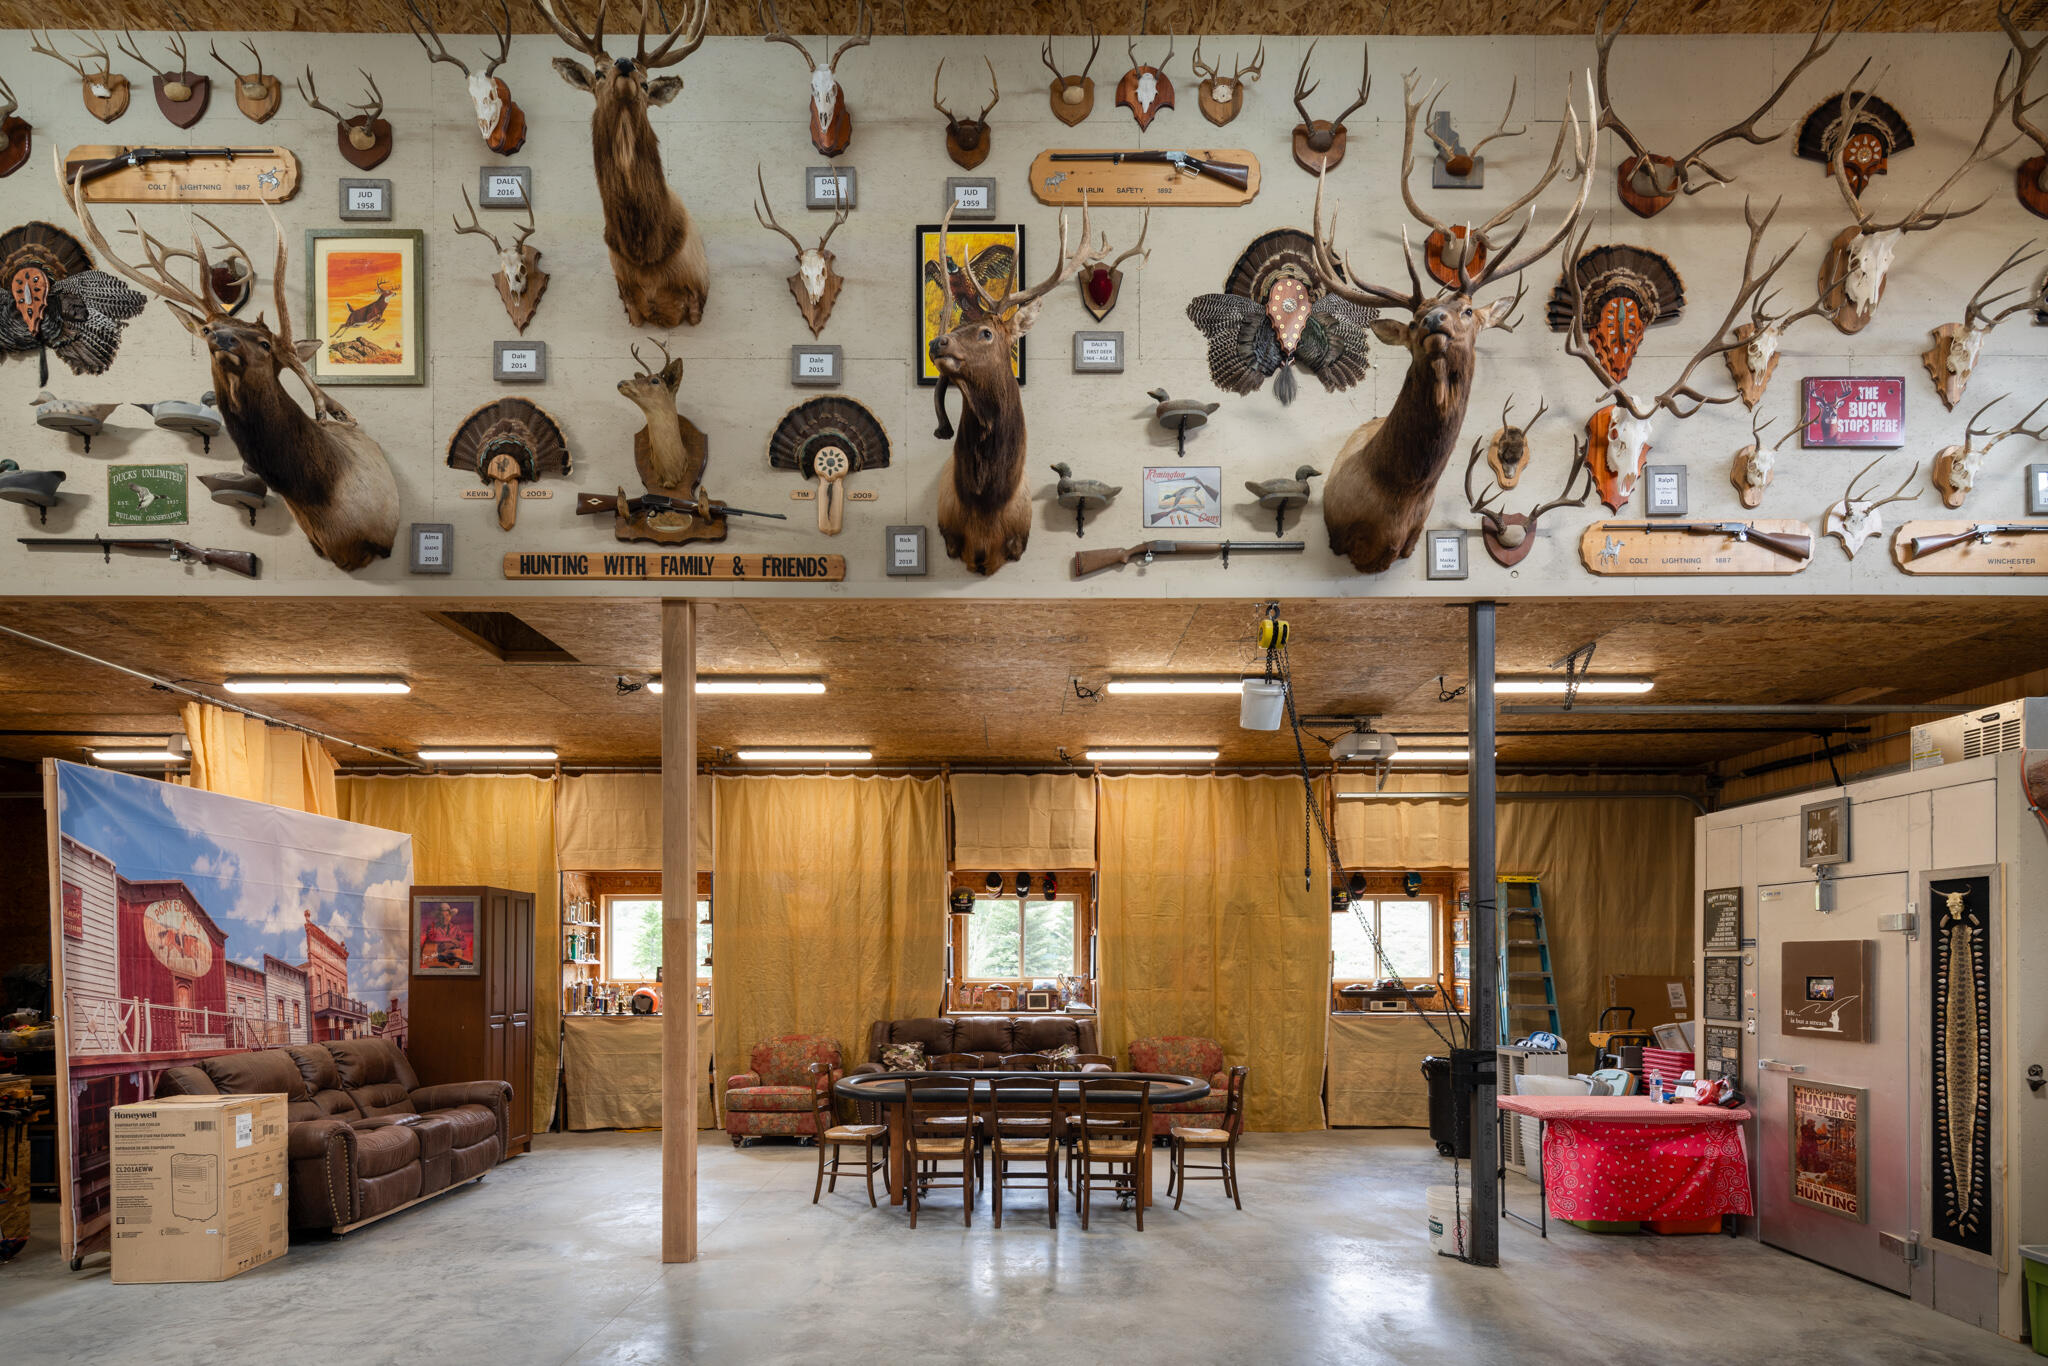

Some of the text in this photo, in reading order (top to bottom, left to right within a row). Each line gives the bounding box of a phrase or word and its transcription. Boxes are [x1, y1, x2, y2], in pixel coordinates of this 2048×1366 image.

[1858, 386, 1879, 400] THE
[1848, 402, 1887, 418] BUCK
[1837, 419, 1898, 433] STOPS HERE
[113, 469, 183, 484] DUCKS UNLIMITED
[1145, 468, 1186, 482] Remington
[145, 510, 182, 521] CONSERVATION
[520, 555, 828, 577] HUNTING WITH FAMILY & FRIENDS
[155, 901, 171, 920] PONY
[1795, 1092, 1856, 1113] HUNTING
[114, 1111, 157, 1120] Honeywell
[1796, 1104, 1856, 1120] WHEN YOU GET OLD
[1795, 1184, 1856, 1213] HUNTING
